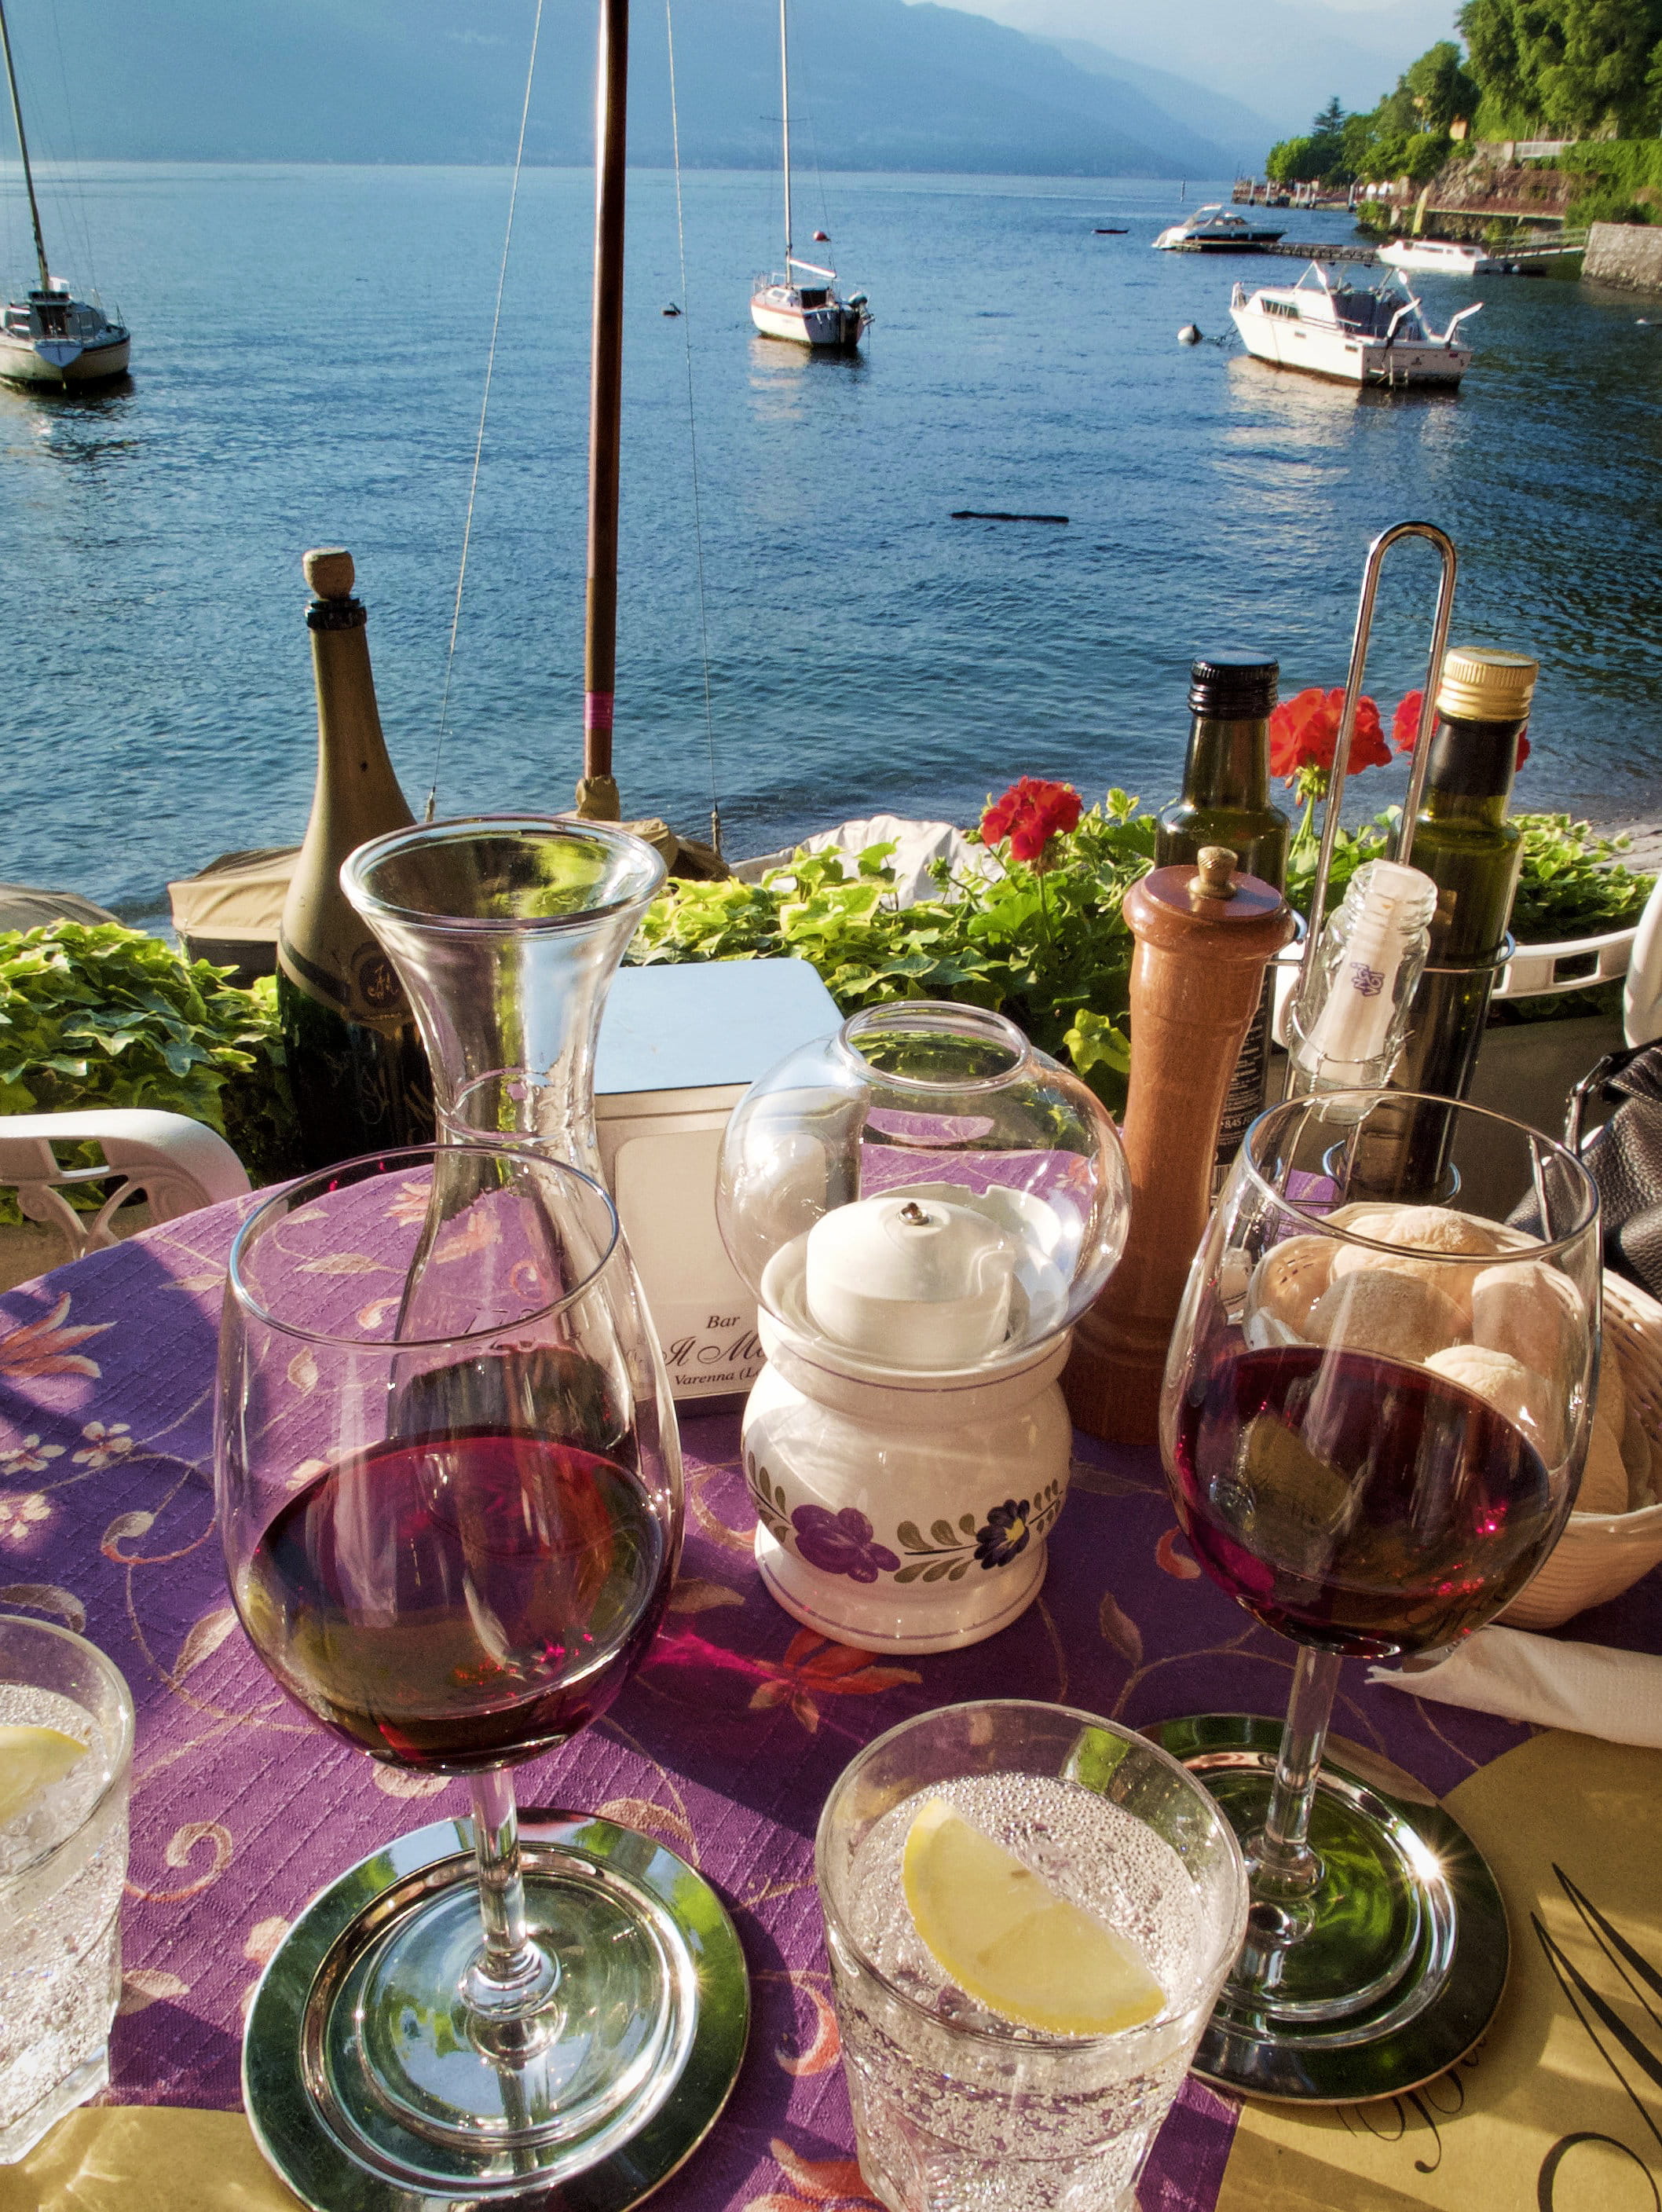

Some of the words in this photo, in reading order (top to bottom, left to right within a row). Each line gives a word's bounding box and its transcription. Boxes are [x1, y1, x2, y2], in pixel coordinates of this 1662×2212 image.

[706, 1315, 741, 1329] Bar
[663, 1335, 697, 1367] Il
[675, 1372, 735, 1386] Varenna
